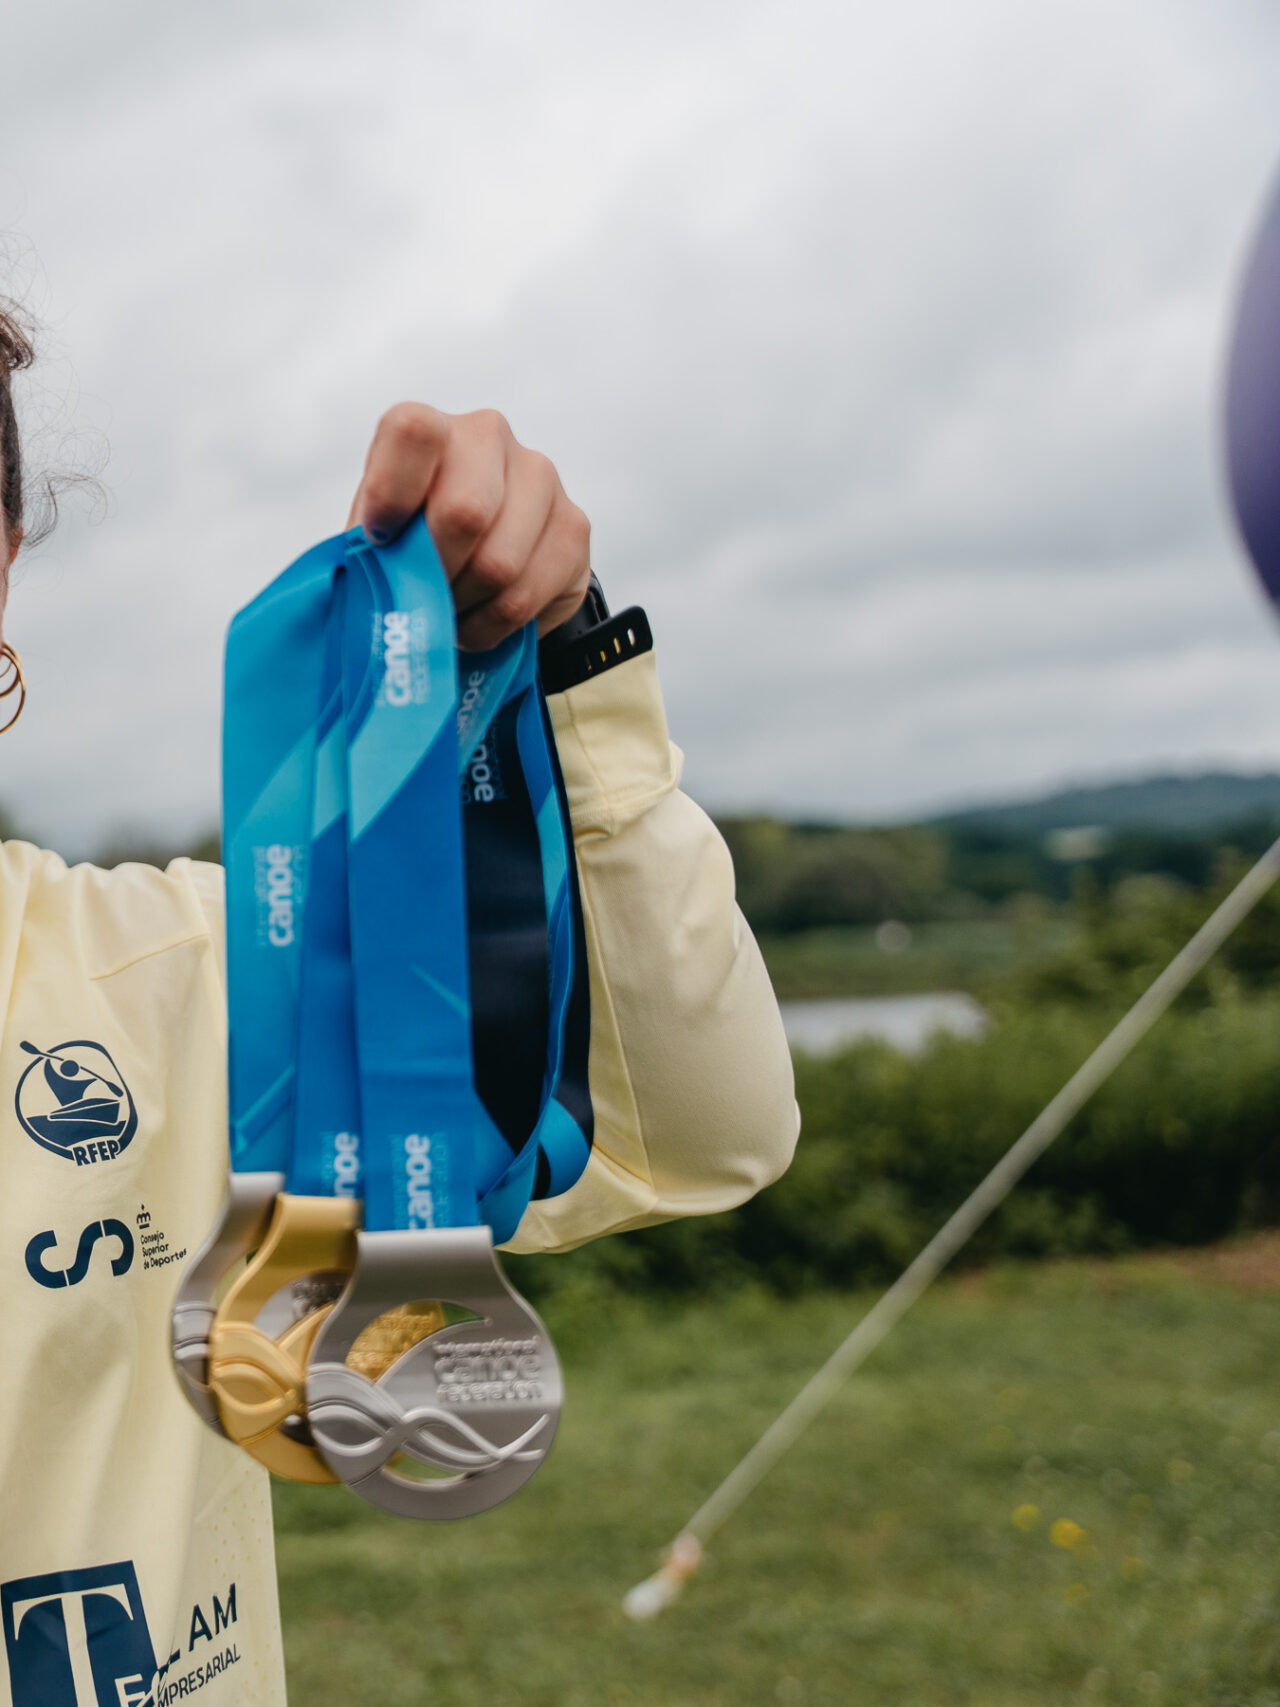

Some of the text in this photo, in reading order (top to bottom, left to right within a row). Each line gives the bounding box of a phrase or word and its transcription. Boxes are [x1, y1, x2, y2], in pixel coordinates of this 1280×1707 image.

[383, 611, 413, 707] canoe
[266, 843, 295, 947] canoe
[73, 1139, 120, 1167] RFEP
[333, 1131, 359, 1198] noe
[140, 1230, 165, 1245] Consejo
[142, 1243, 169, 1258] Superior
[434, 1355, 542, 1383] canoe
[158, 1643, 241, 1707] MPRESARIAL
